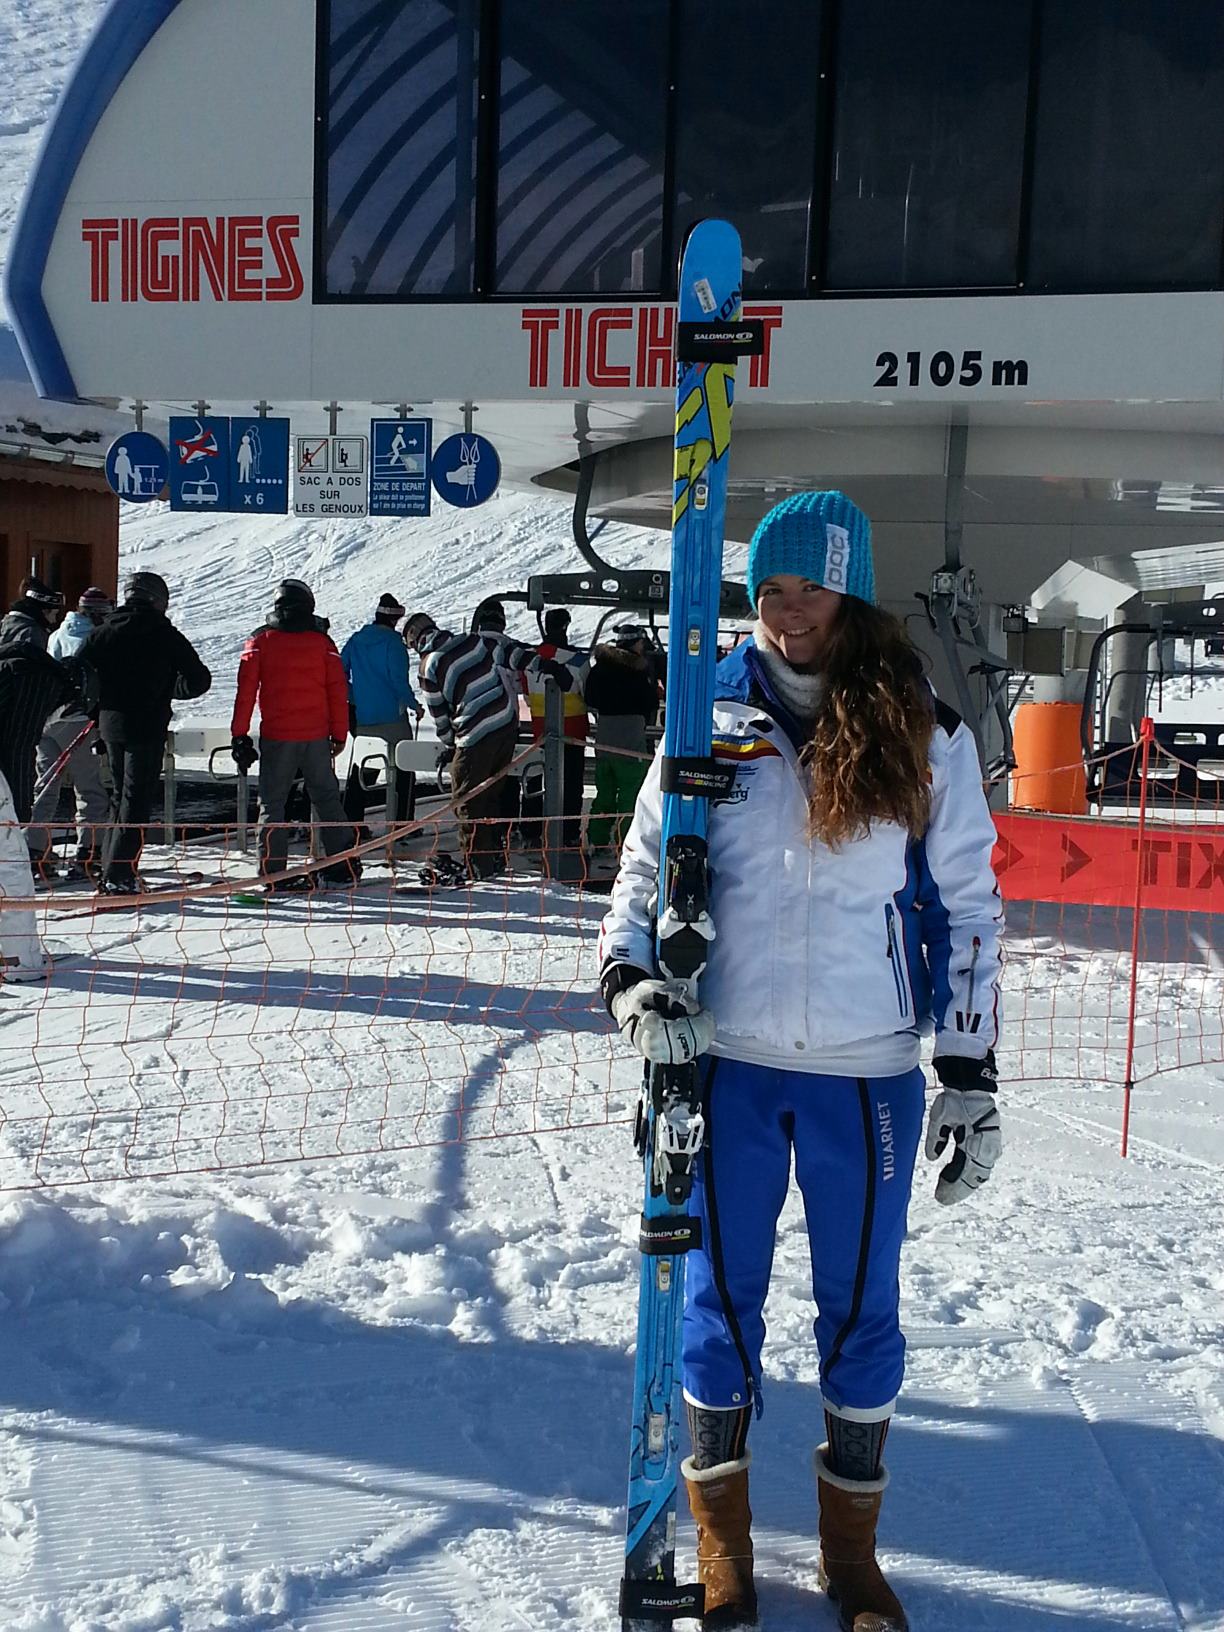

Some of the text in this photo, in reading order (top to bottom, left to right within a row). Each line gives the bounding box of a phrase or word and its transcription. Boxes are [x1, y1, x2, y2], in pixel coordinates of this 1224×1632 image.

[82, 215, 304, 302] TIGNES
[522, 306, 782, 387] TICHT
[873, 351, 1028, 387] 2105 m
[299, 476, 361, 486] SAC A DOS
[391, 482, 400, 491] DE
[256, 492, 264, 505] 6
[319, 490, 340, 500] SUR
[295, 503, 315, 513] LES
[320, 503, 364, 513] GENOUX
[641, 1598, 680, 1606] SALOMON
